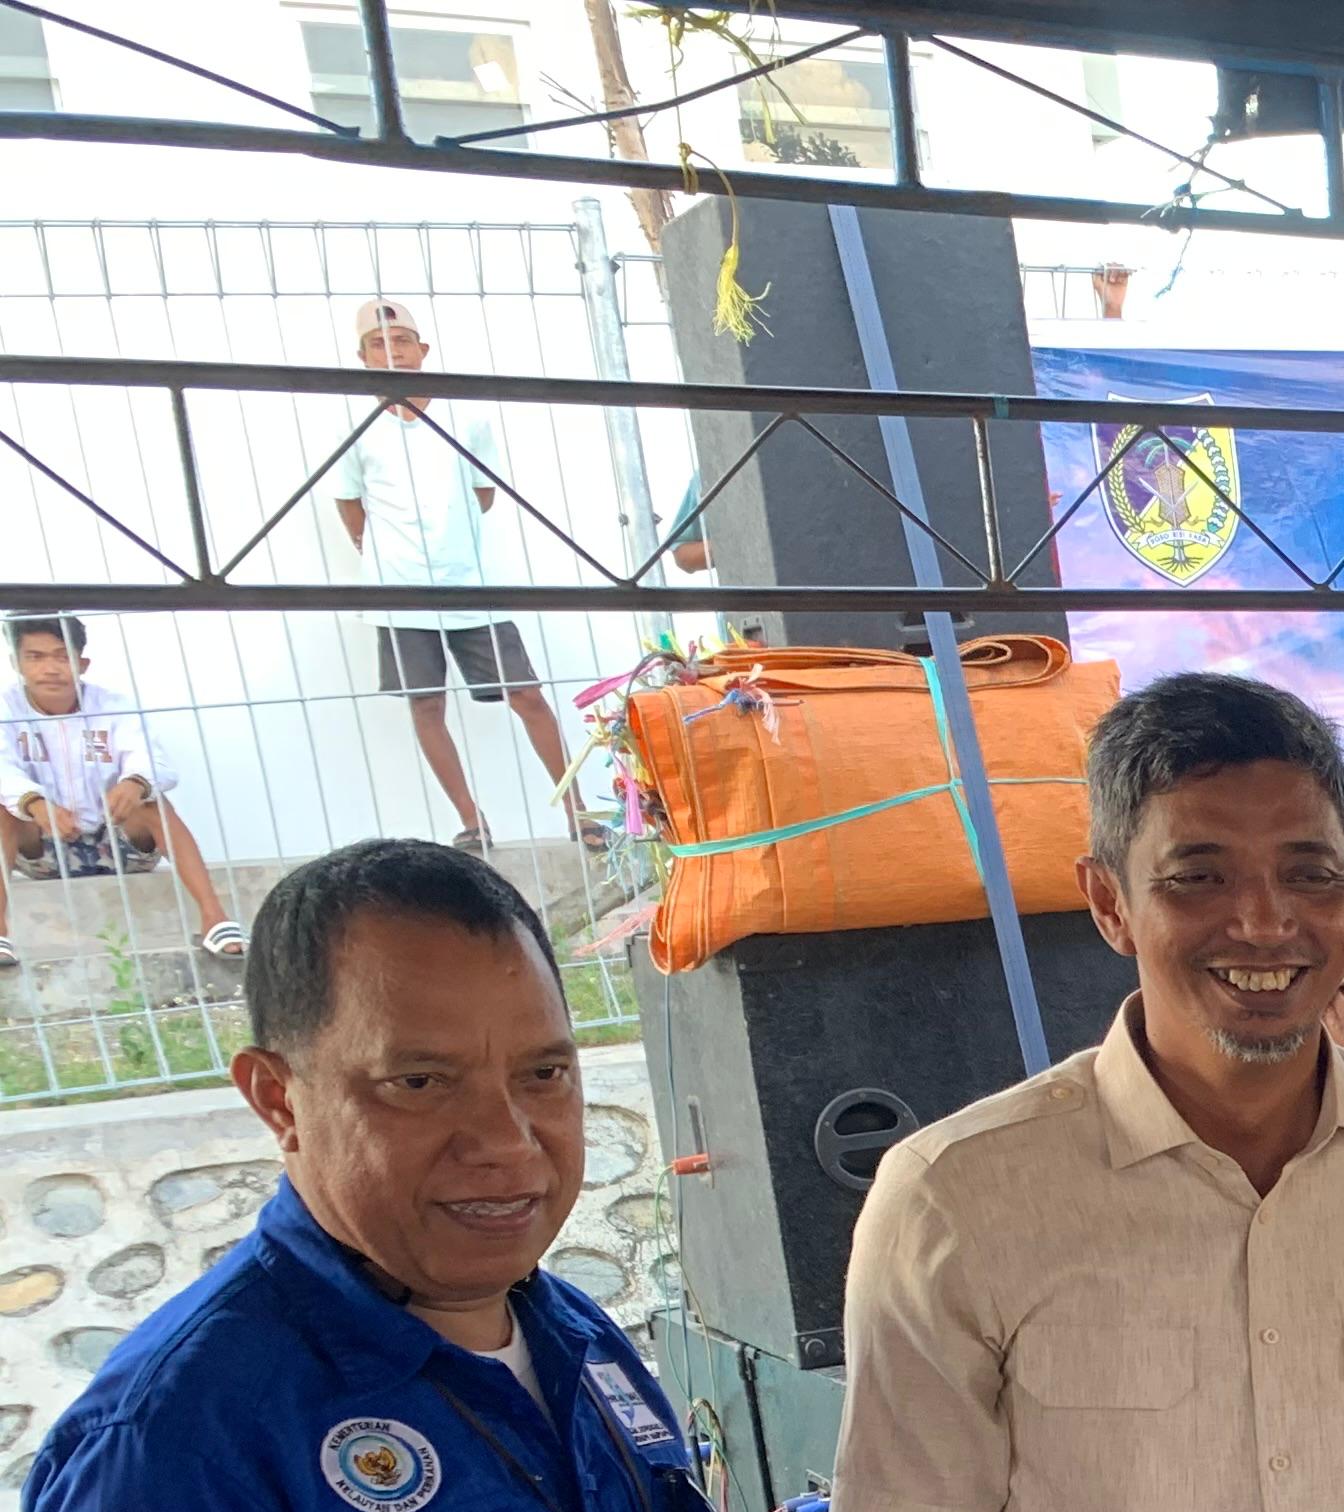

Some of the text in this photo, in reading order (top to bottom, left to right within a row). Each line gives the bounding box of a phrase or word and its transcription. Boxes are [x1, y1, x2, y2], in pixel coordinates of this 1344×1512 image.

[328, 1422, 391, 1450] KEMENTERIAN
[336, 1480, 391, 1512] KELAUTAN
[393, 1497, 419, 1512] DAN
